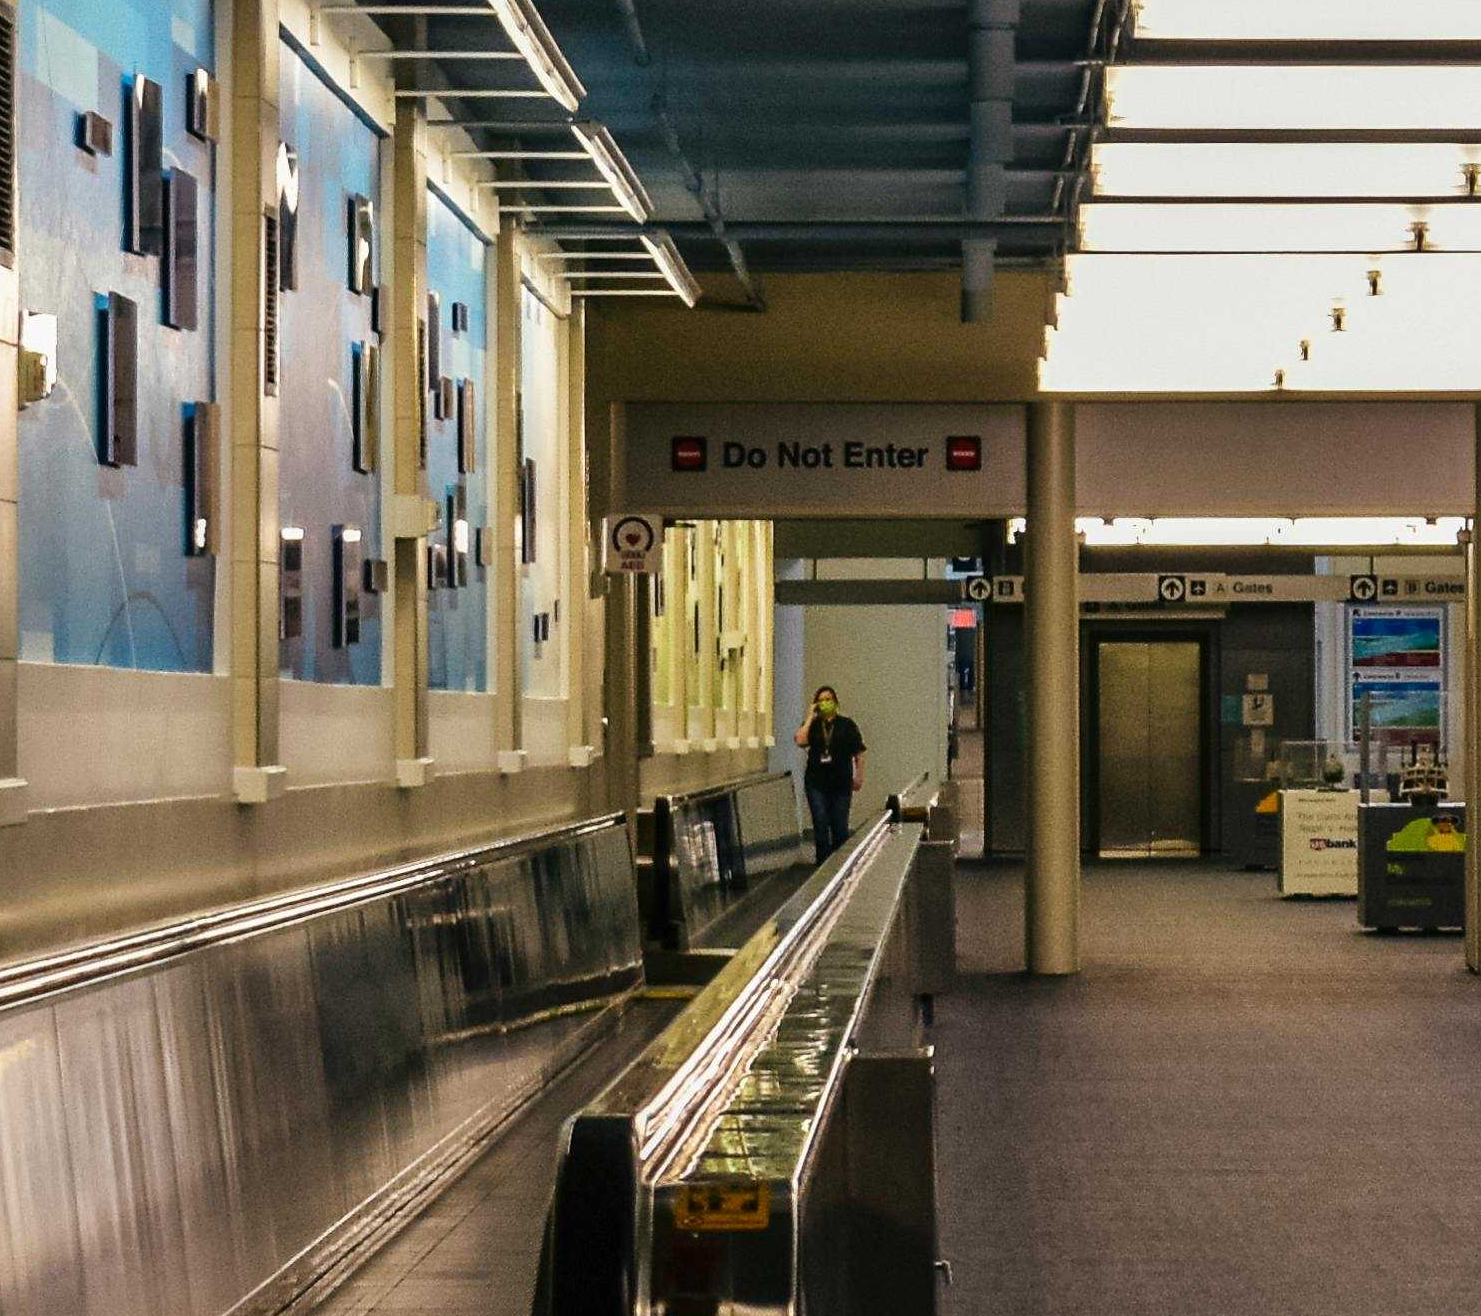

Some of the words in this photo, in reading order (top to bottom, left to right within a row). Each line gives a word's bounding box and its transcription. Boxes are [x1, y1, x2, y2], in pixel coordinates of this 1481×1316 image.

[723, 441, 767, 468] Do
[778, 441, 833, 468] Not
[844, 441, 929, 468] Enter
[1232, 582, 1273, 595] Gates
[1425, 582, 1465, 595] Gates
